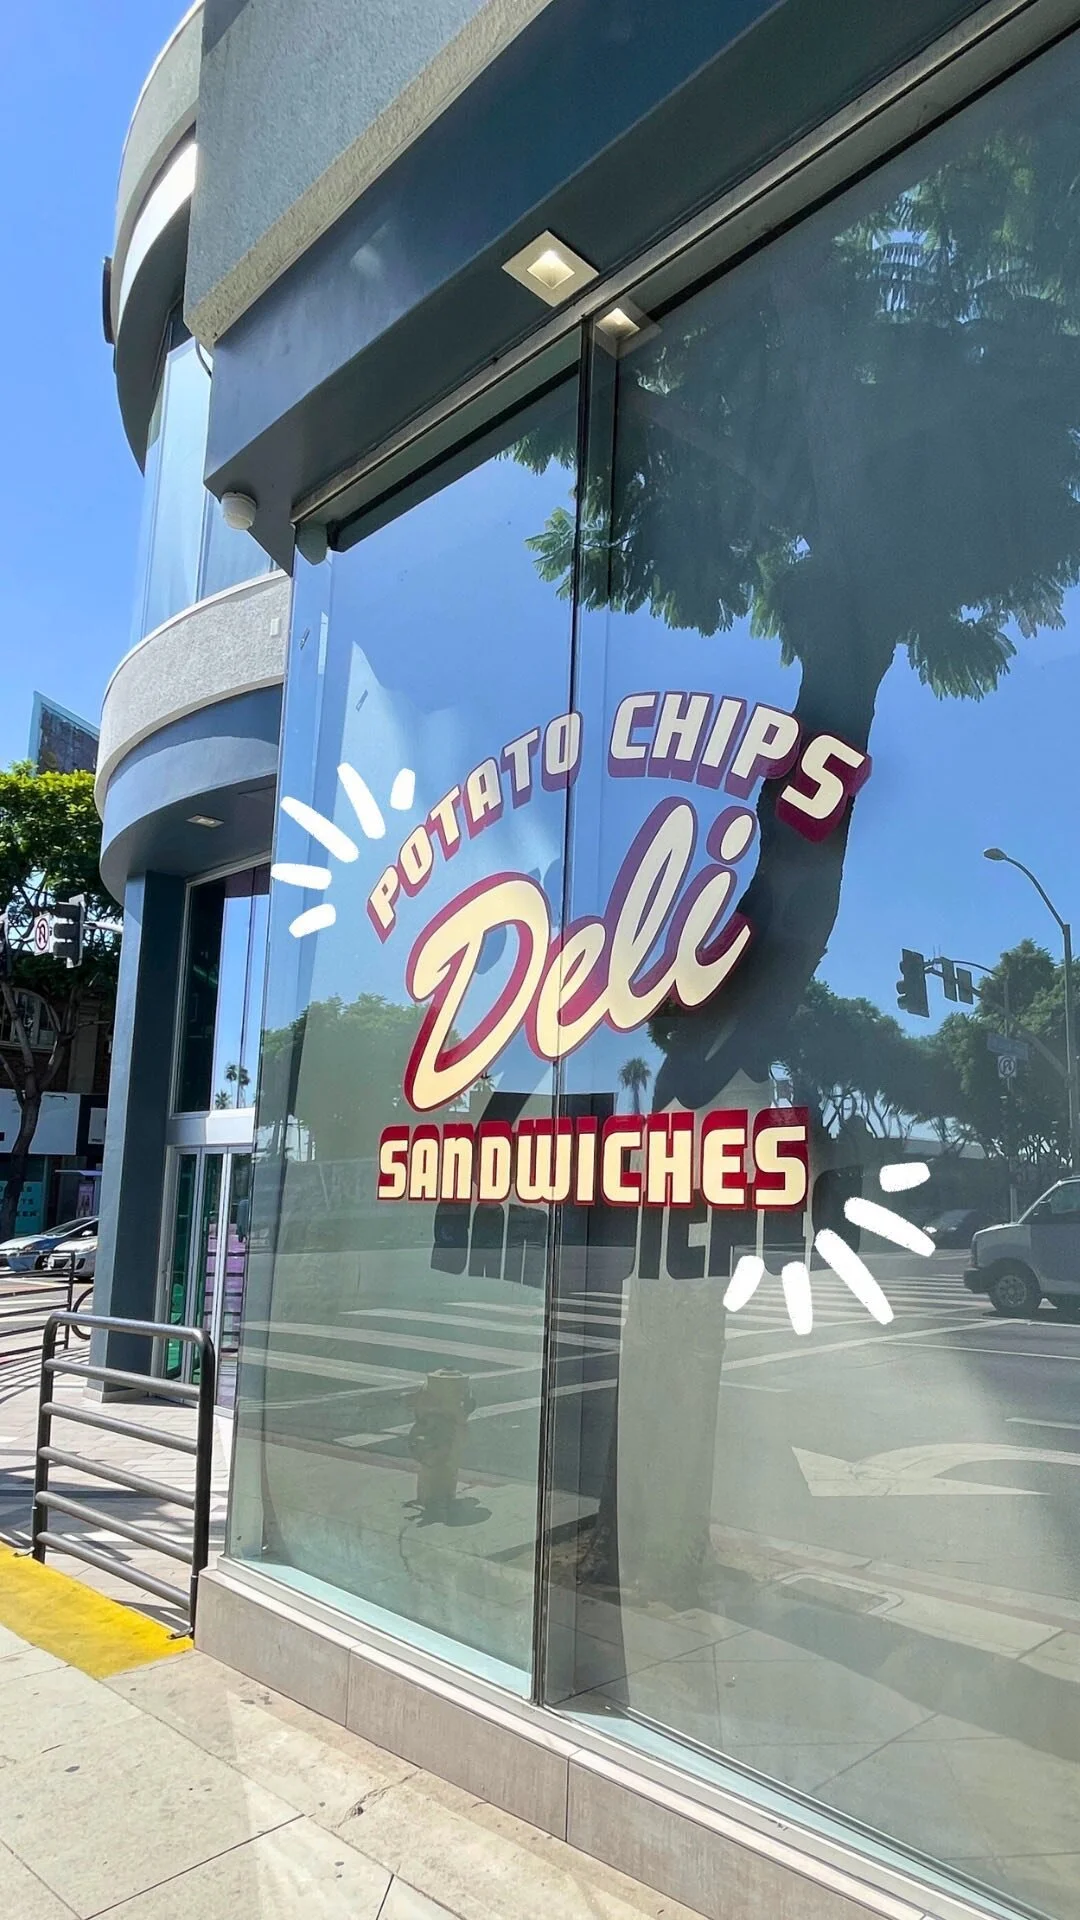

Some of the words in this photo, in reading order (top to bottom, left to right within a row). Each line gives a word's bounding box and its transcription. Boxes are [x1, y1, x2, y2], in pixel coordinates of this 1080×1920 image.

[367, 711, 583, 943] POTATO
[607, 691, 872, 842] CHIPS
[404, 796, 753, 1112] Deli
[377, 1107, 810, 1210] SANDWICHES
